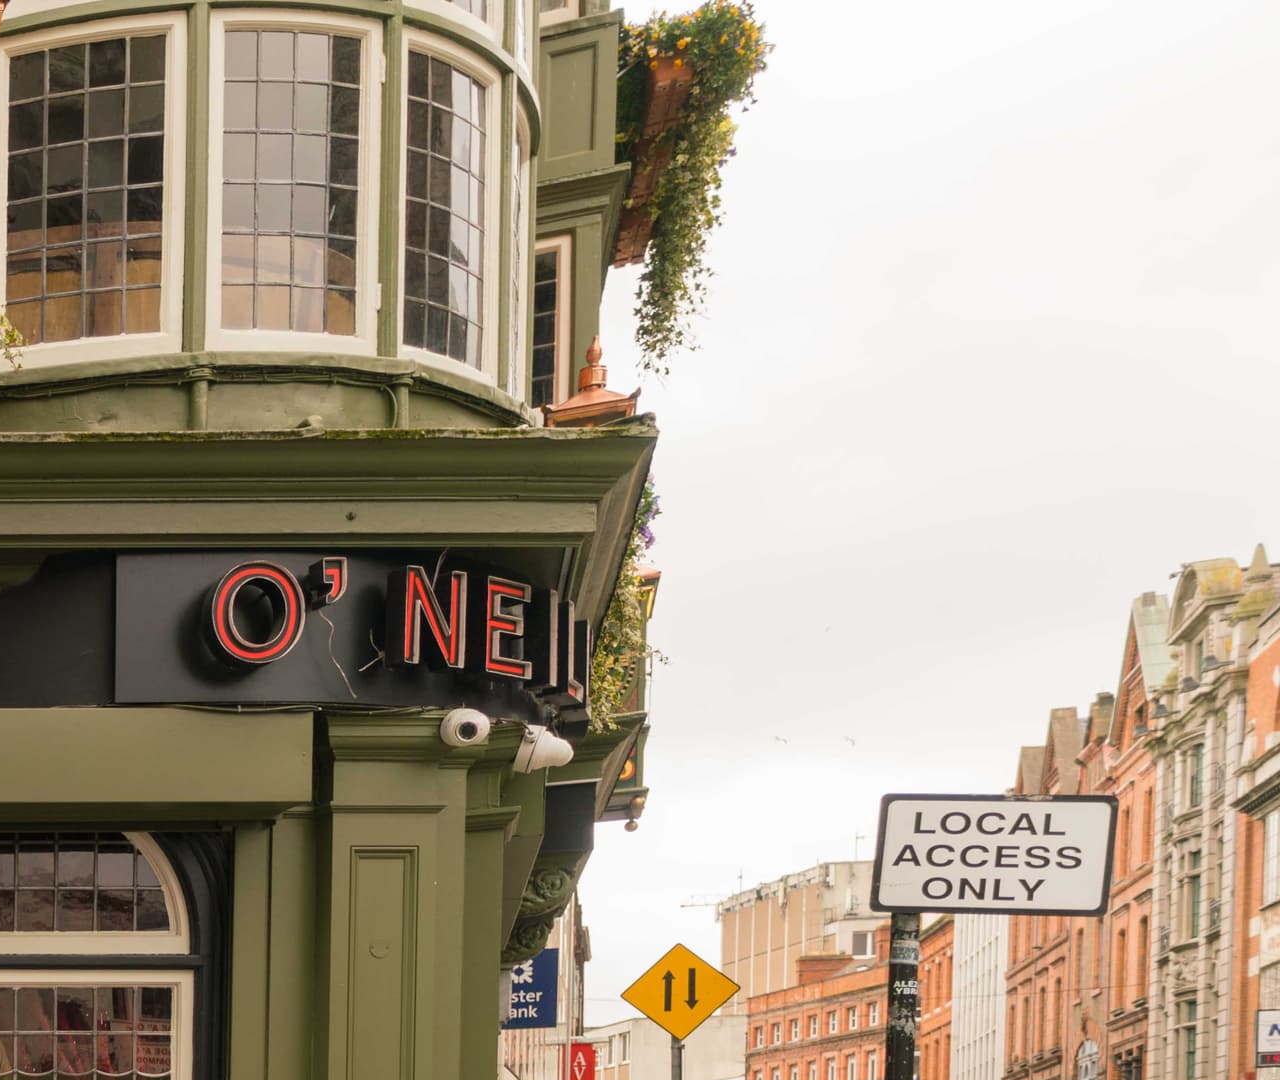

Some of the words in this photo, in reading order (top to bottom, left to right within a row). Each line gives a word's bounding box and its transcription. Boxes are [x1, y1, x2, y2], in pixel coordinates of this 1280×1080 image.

[913, 811, 1067, 836] LOCAL
[892, 844, 1084, 870] ACCESS
[921, 877, 1047, 902] ONLY
[511, 990, 543, 1003] ster
